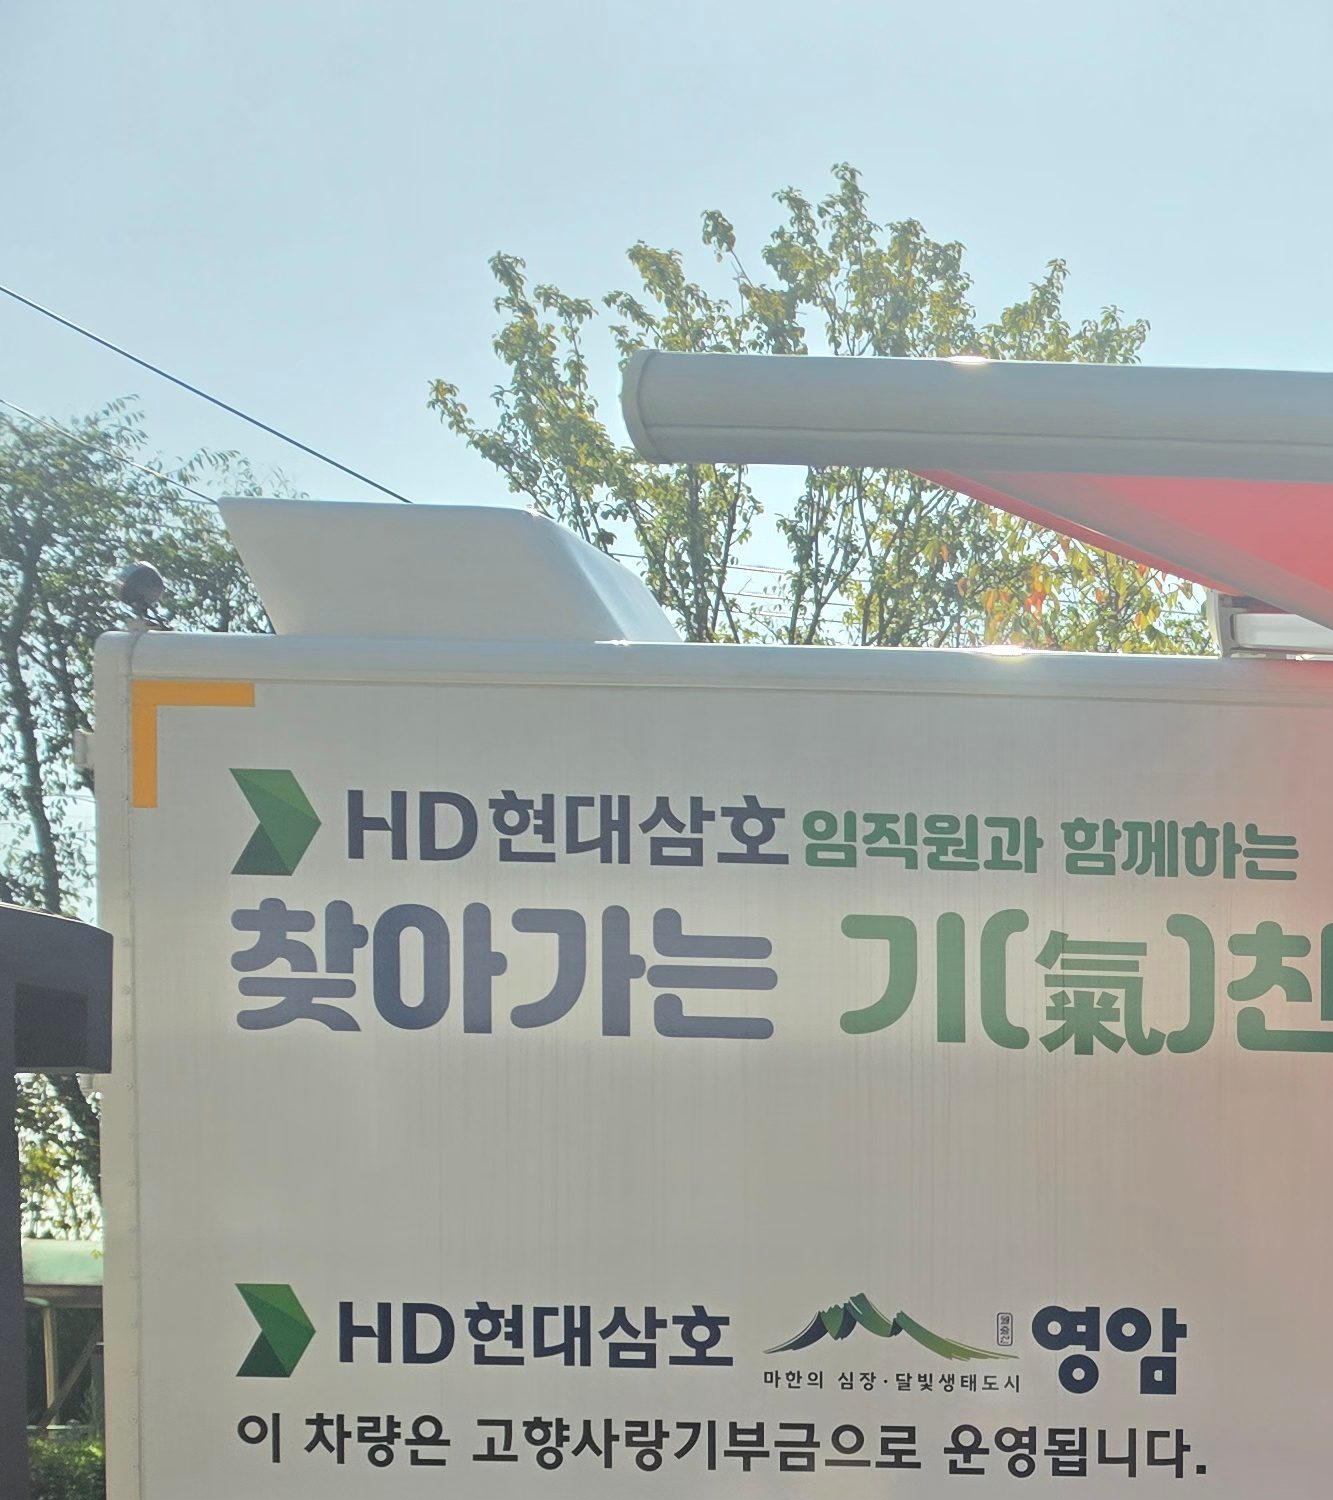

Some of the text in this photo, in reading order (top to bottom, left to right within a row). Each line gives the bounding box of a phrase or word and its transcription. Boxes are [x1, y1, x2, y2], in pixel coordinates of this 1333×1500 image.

[802, 809, 1044, 874] 임직원과
[1060, 816, 1300, 881] 함께하는
[230, 896, 779, 1041] 찾아가는
[763, 1370, 824, 1390] 마한의
[1031, 1305, 1188, 1395] 영암
[237, 1412, 1207, 1479] 이 차량은 고향사랑기부금으로 운영됩니다.
